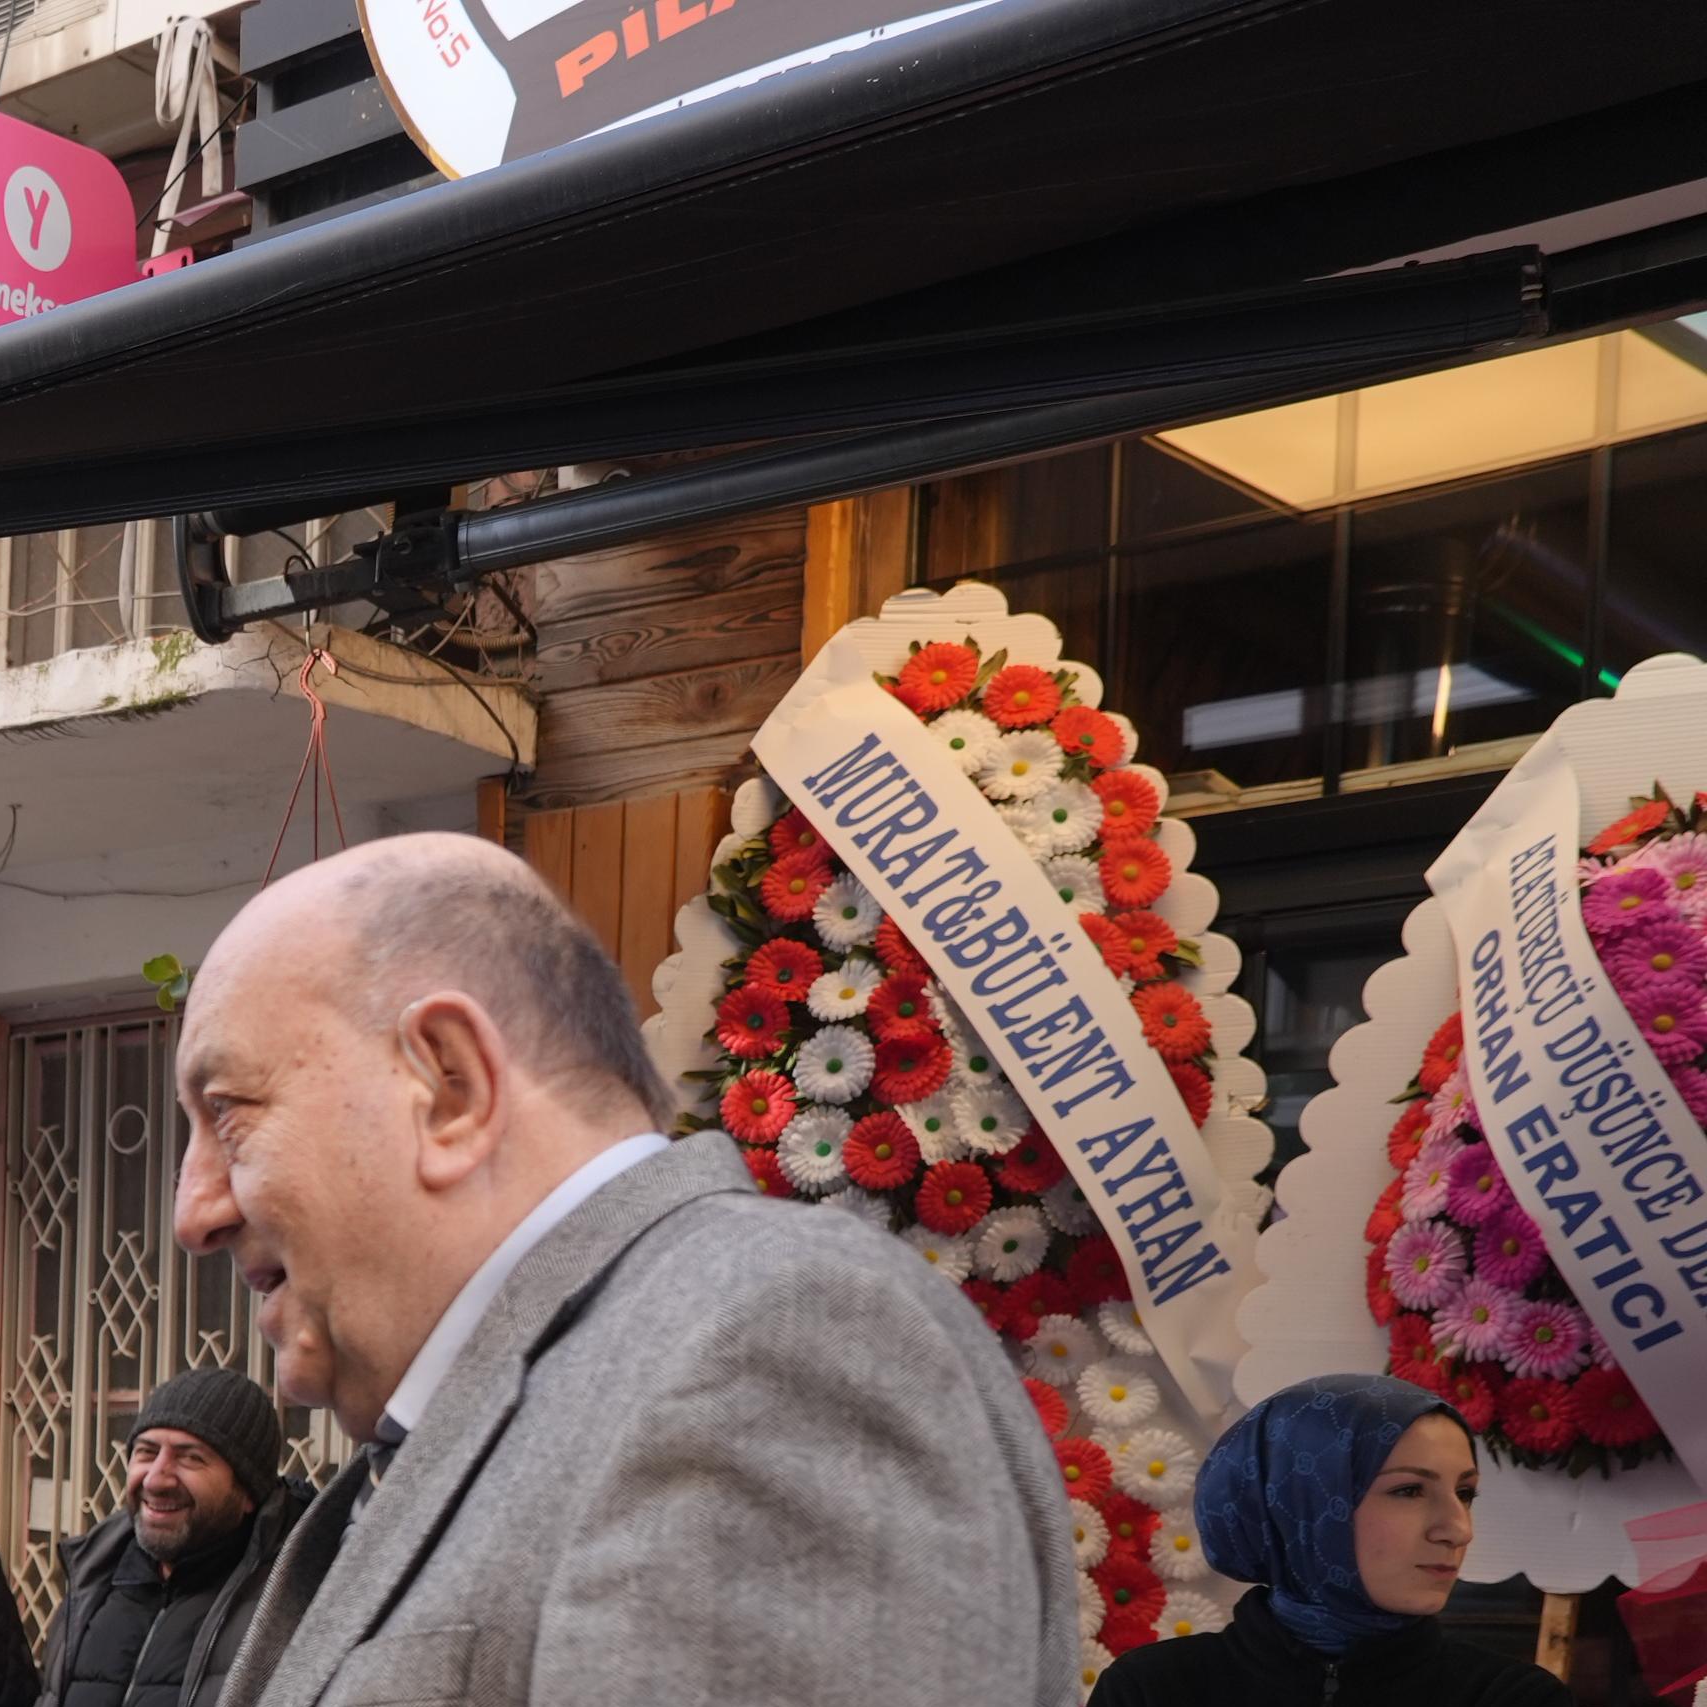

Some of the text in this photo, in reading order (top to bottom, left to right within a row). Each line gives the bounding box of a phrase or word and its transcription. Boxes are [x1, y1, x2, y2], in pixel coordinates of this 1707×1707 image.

[801, 732, 1232, 1308] MURAT&BÜLENT AYHAN
[1510, 833, 1597, 1028] ATATÜRKÇÜ
[1469, 929, 1684, 1354] ORHAN ERATICI
[1544, 1025, 1706, 1223] DÜŞÜNCE
